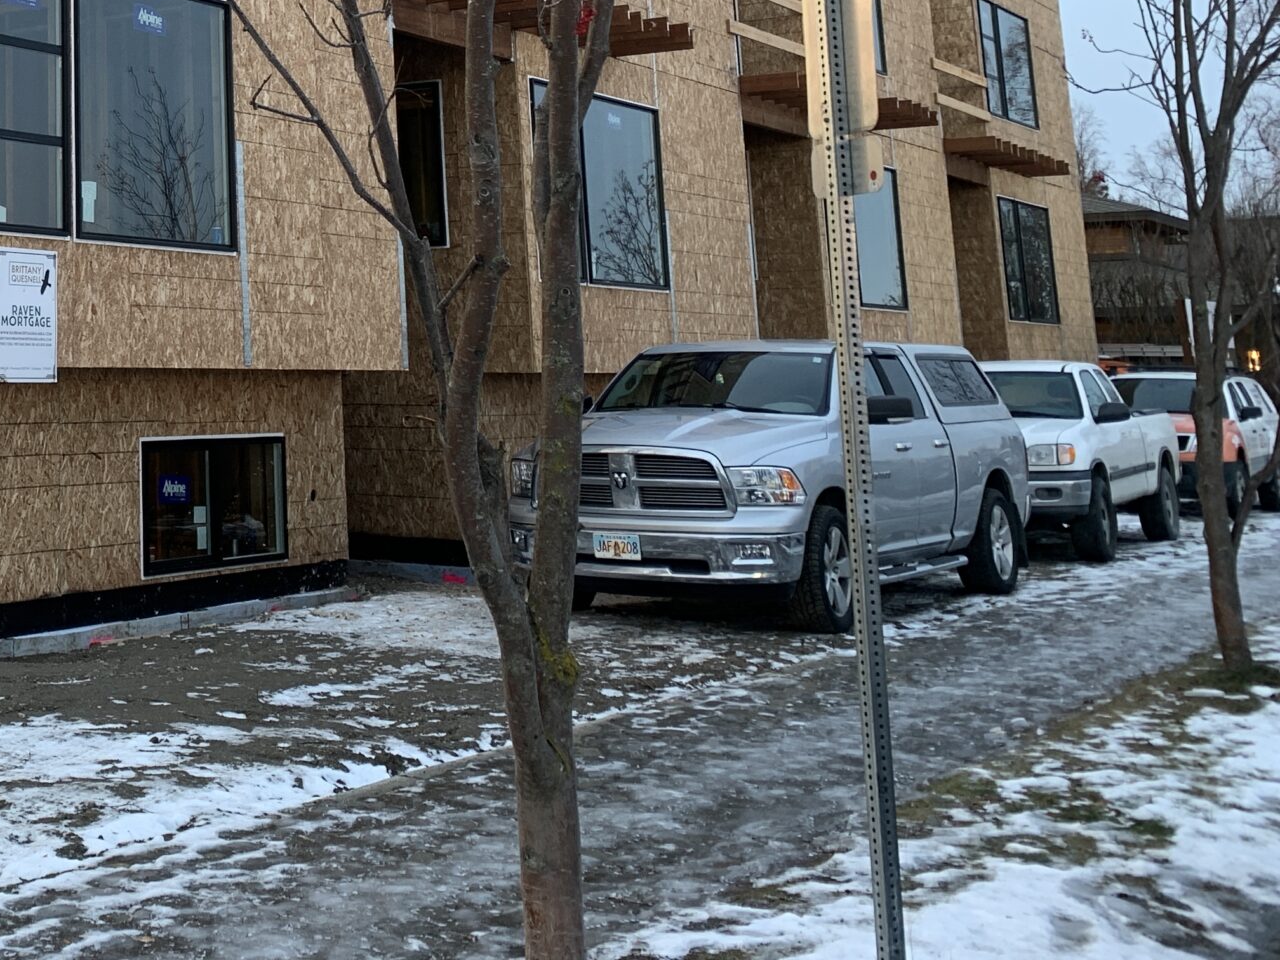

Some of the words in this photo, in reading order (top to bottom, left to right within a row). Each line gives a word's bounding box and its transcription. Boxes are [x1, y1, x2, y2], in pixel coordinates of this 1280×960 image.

[137, 8, 163, 25] Alpine
[11, 265, 42, 274] BRITTANY
[11, 275, 41, 283] QUESNELL
[11, 305, 41, 316] RAVEN
[1, 315, 52, 327] MORTGAGE
[162, 480, 186, 496] Alpine
